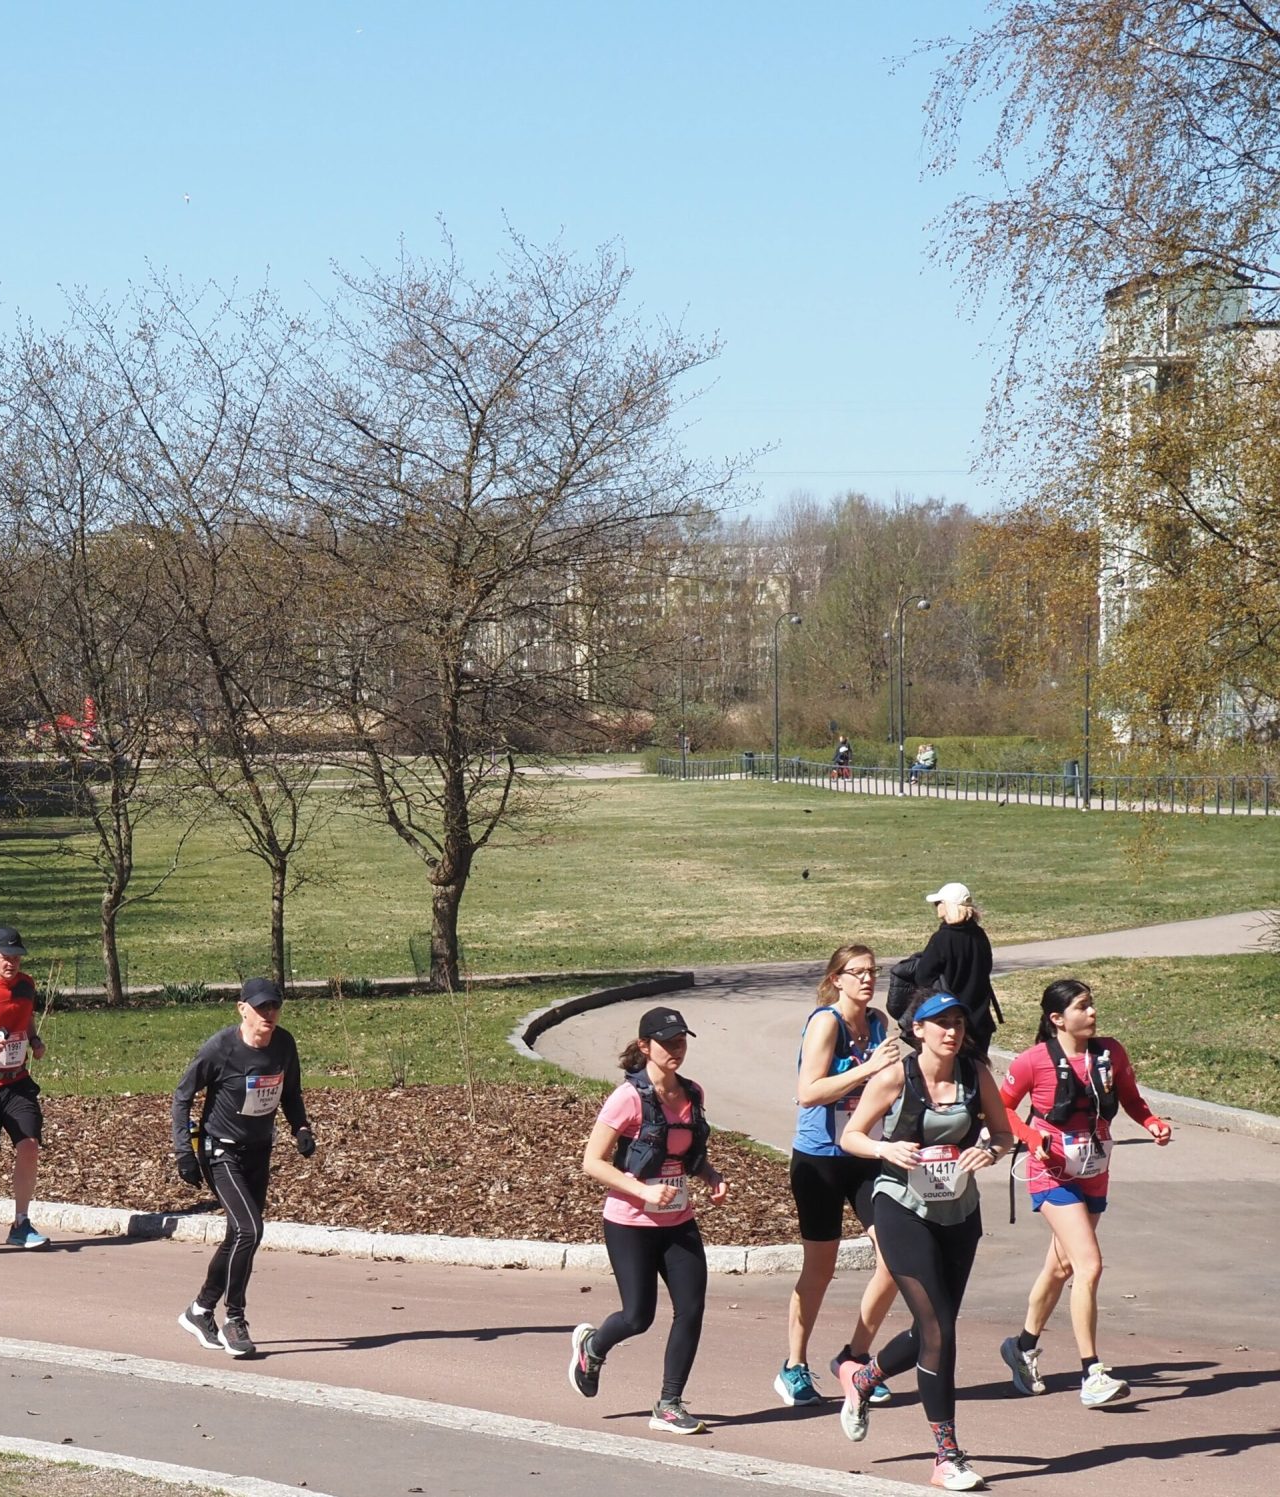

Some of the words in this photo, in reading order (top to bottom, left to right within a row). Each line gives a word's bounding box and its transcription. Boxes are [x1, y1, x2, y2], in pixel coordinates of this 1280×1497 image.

[922, 1162, 956, 1176] 11417
[929, 1176, 951, 1184] LAURA
[922, 1191, 956, 1199] saucony
